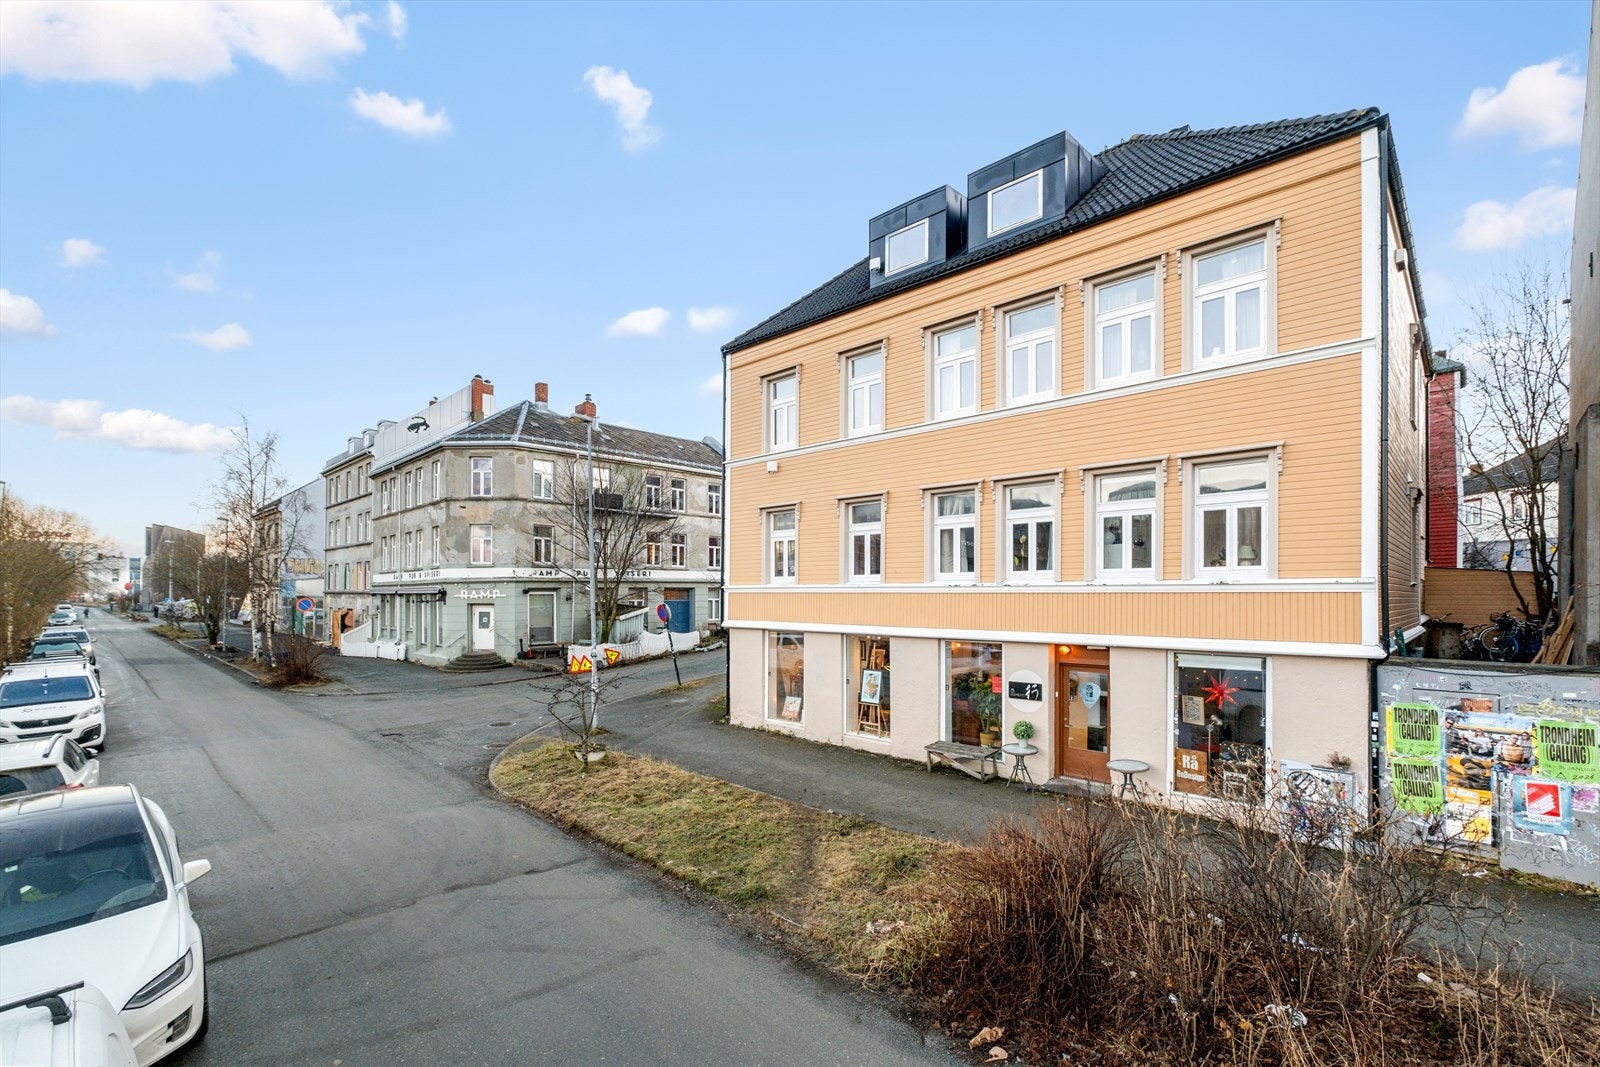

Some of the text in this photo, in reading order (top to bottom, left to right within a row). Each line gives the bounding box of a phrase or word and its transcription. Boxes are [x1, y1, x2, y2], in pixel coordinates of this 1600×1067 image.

[460, 588, 501, 600] RAMP
[1393, 706, 1439, 726] TRONDHEIM
[1539, 725, 1595, 747] TRONDHEIM
[1182, 754, 1199, 771] Rå
[1393, 763, 1440, 783] TRONDHEIM
